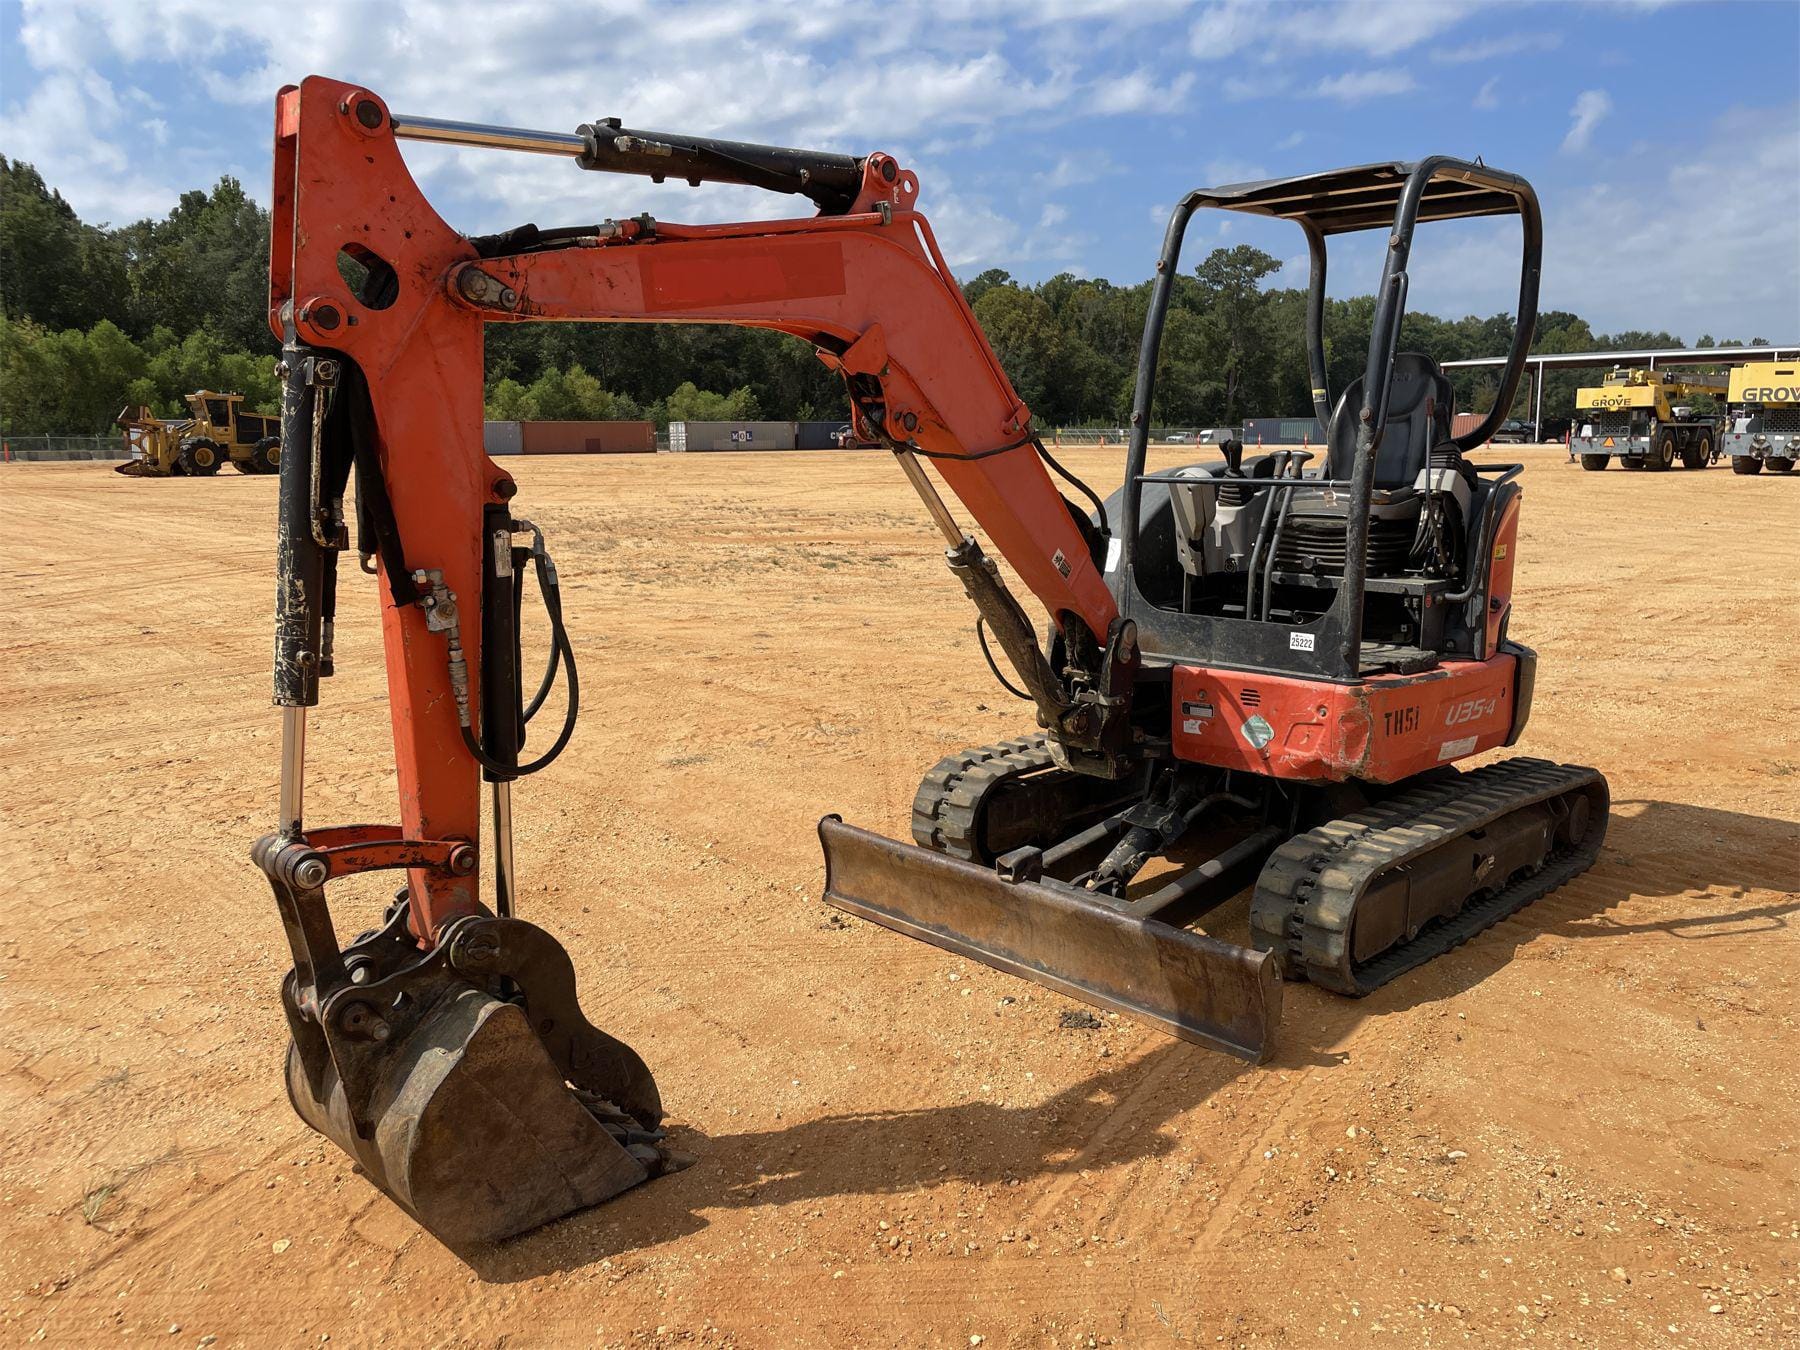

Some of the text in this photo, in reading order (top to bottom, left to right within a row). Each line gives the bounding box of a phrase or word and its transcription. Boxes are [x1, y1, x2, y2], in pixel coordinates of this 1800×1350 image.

[1592, 398, 1632, 407] GROVE
[731, 430, 752, 441] MOL
[1291, 637, 1313, 649] 25222
[1445, 699, 1497, 726] U35-4
